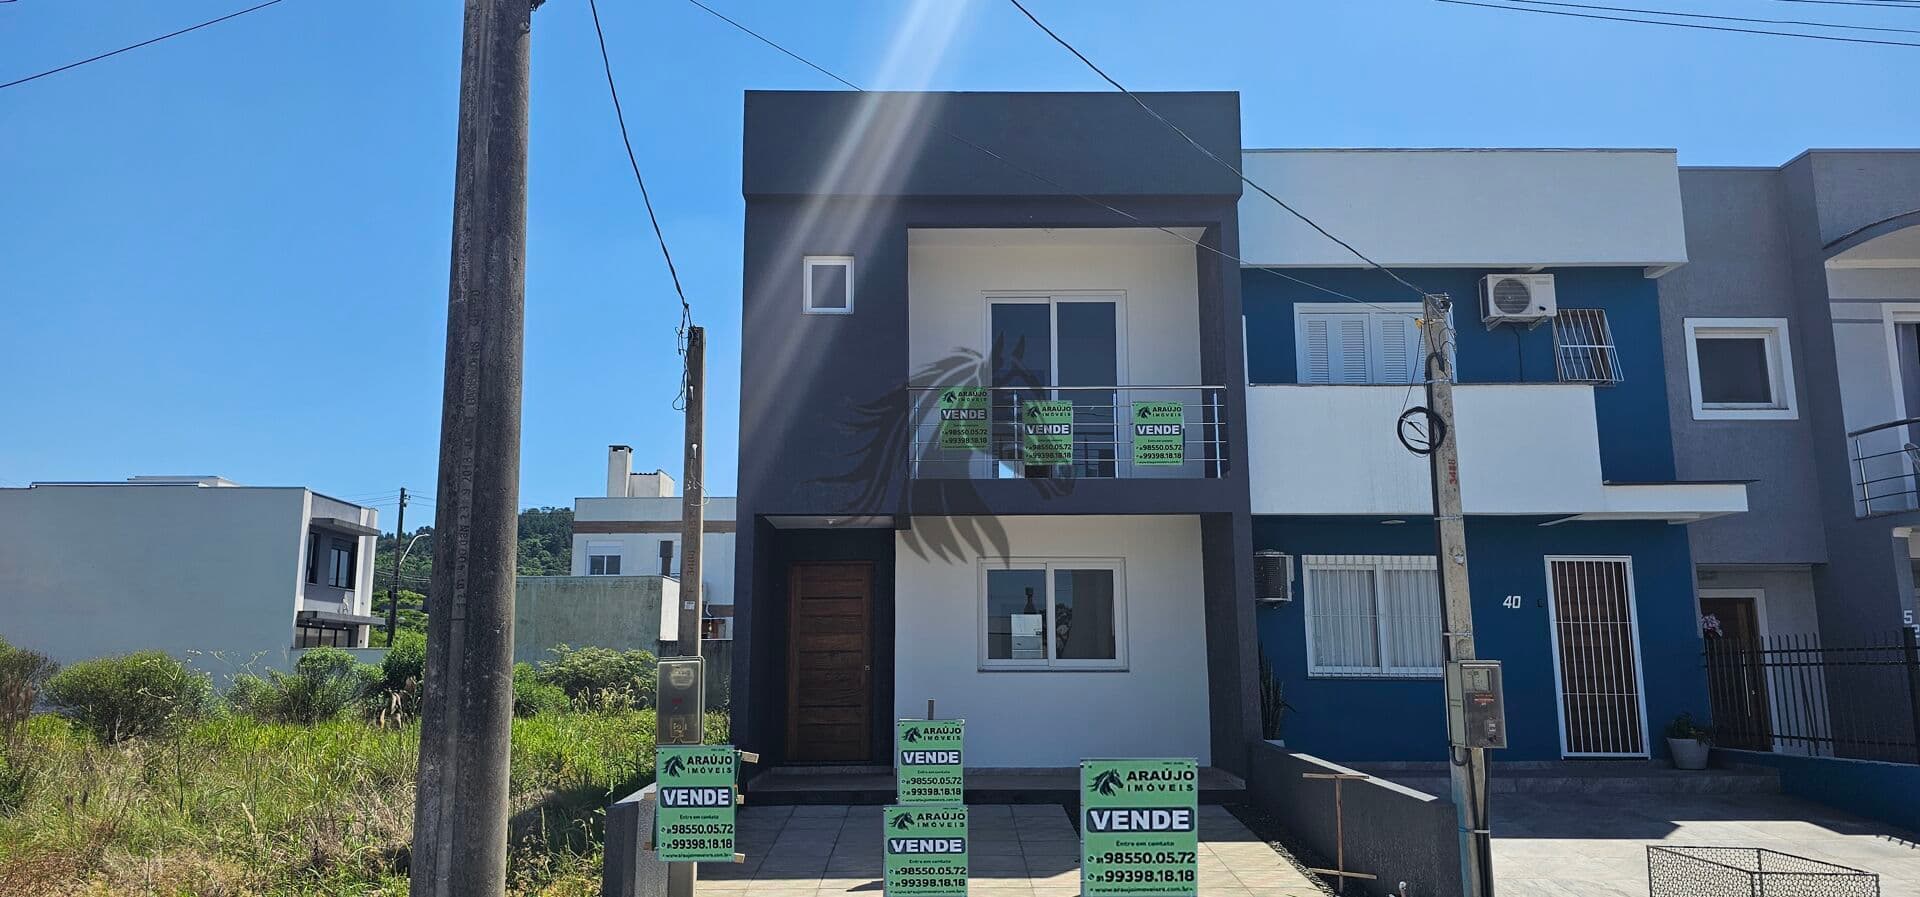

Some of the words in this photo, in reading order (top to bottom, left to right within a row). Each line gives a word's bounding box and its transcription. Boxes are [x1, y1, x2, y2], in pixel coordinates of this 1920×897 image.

[942, 409, 985, 419] VENDE
[1026, 424, 1069, 434] VENDE
[1137, 424, 1180, 435] VENDE
[1502, 595, 1522, 609] 40
[923, 725, 962, 735] ARAÚJO
[687, 755, 732, 765] ARAÚJO
[903, 751, 959, 764] VENDE
[687, 766, 732, 774] IMÓVEIS
[1126, 768, 1195, 781] ARAÚJO
[910, 776, 962, 785] 98550.05.72
[911, 788, 961, 796] 99398.18.18
[1127, 783, 1194, 792] IMÓVEIS
[663, 789, 730, 806] VENDE
[916, 811, 966, 821] ARAÚJO
[1090, 809, 1190, 830] VENDE
[671, 823, 734, 834] 98550.05.72
[672, 838, 733, 849] 99398.18.18
[890, 839, 963, 853] VENDE
[1104, 852, 1195, 864] 98550.05.72
[900, 866, 967, 875] 98550.05.72
[1104, 870, 1195, 882] 99398.18.18
[901, 878, 966, 888] 99398.18.18
